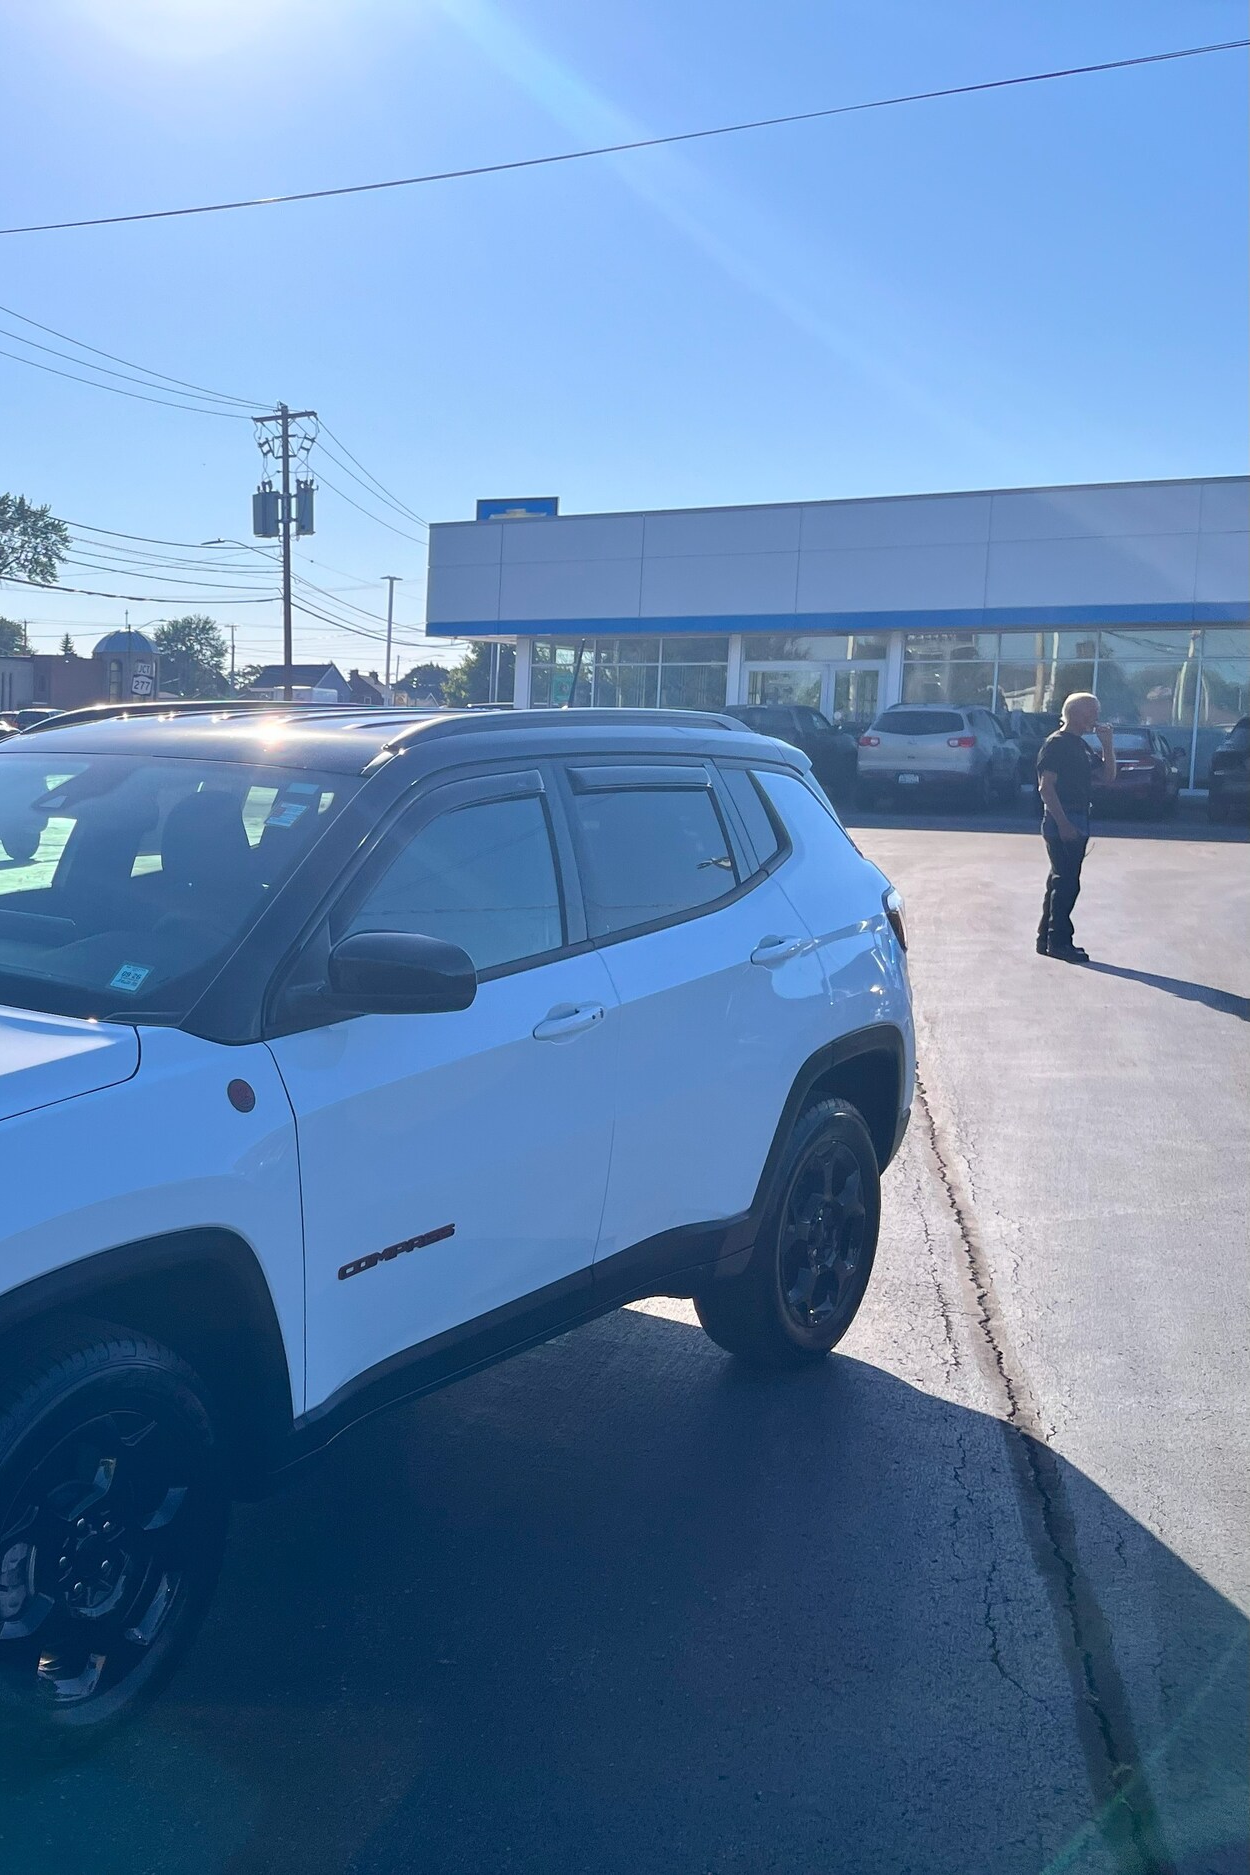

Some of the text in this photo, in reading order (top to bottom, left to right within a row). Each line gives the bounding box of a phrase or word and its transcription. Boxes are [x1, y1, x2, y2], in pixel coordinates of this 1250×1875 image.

[138, 664, 150, 674] JCT
[133, 680, 151, 691] 277
[338, 1223, 455, 1281] COMPASS
